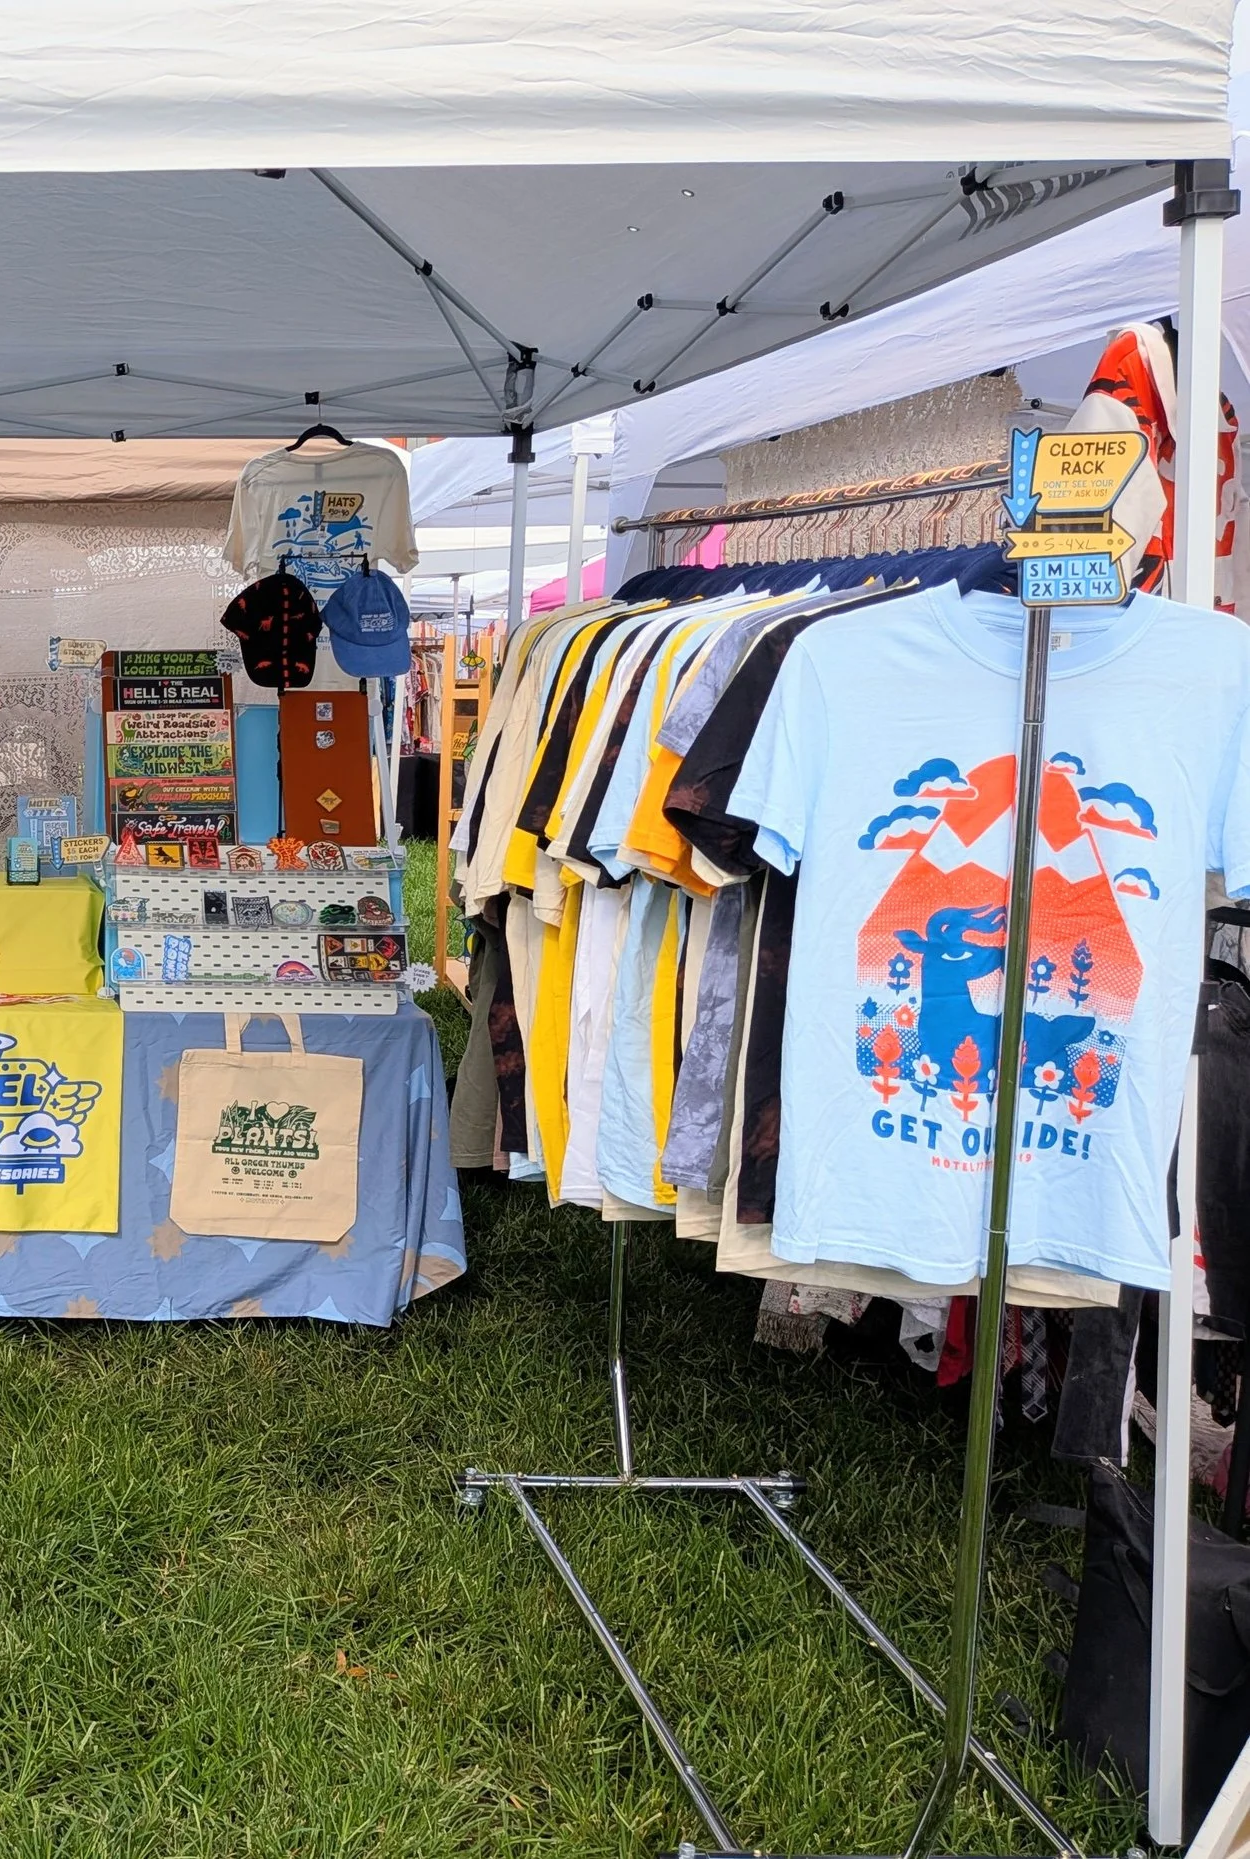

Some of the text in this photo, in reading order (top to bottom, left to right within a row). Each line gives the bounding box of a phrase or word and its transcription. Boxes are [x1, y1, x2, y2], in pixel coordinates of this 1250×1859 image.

[1049, 441, 1127, 457] CLOTHES
[1061, 461, 1105, 476] RACK
[1042, 479, 1114, 489] DON'T SEE YOUR
[1048, 490, 1072, 499] SIZE?
[1093, 489, 1108, 497] US!
[327, 497, 356, 507] HATS
[1030, 562, 1107, 577] S M L XL
[1031, 581, 1113, 597] 2X 3X 4X
[63, 649, 97, 657] STICKERS
[134, 653, 194, 664] HIKE YOUR
[123, 665, 204, 675] LOCAL TRAILS!
[123, 686, 219, 699] HELL IS REAL
[135, 731, 208, 739] Attractions
[130, 745, 213, 759] EXPLORE THE
[143, 762, 201, 774] MIDWEST
[29, 799, 60, 808] MOTEL
[135, 817, 225, 838] Safe Travels!
[64, 838, 104, 848] STICKERS
[78, 846, 99, 854] EACH
[249, 1100, 259, 1121] I
[872, 1109, 942, 1150] GET
[217, 1126, 318, 1150] PLANTS!
[224, 1157, 306, 1170] ALL GREEN THUMBS
[244, 1168, 285, 1177] WELCOME
